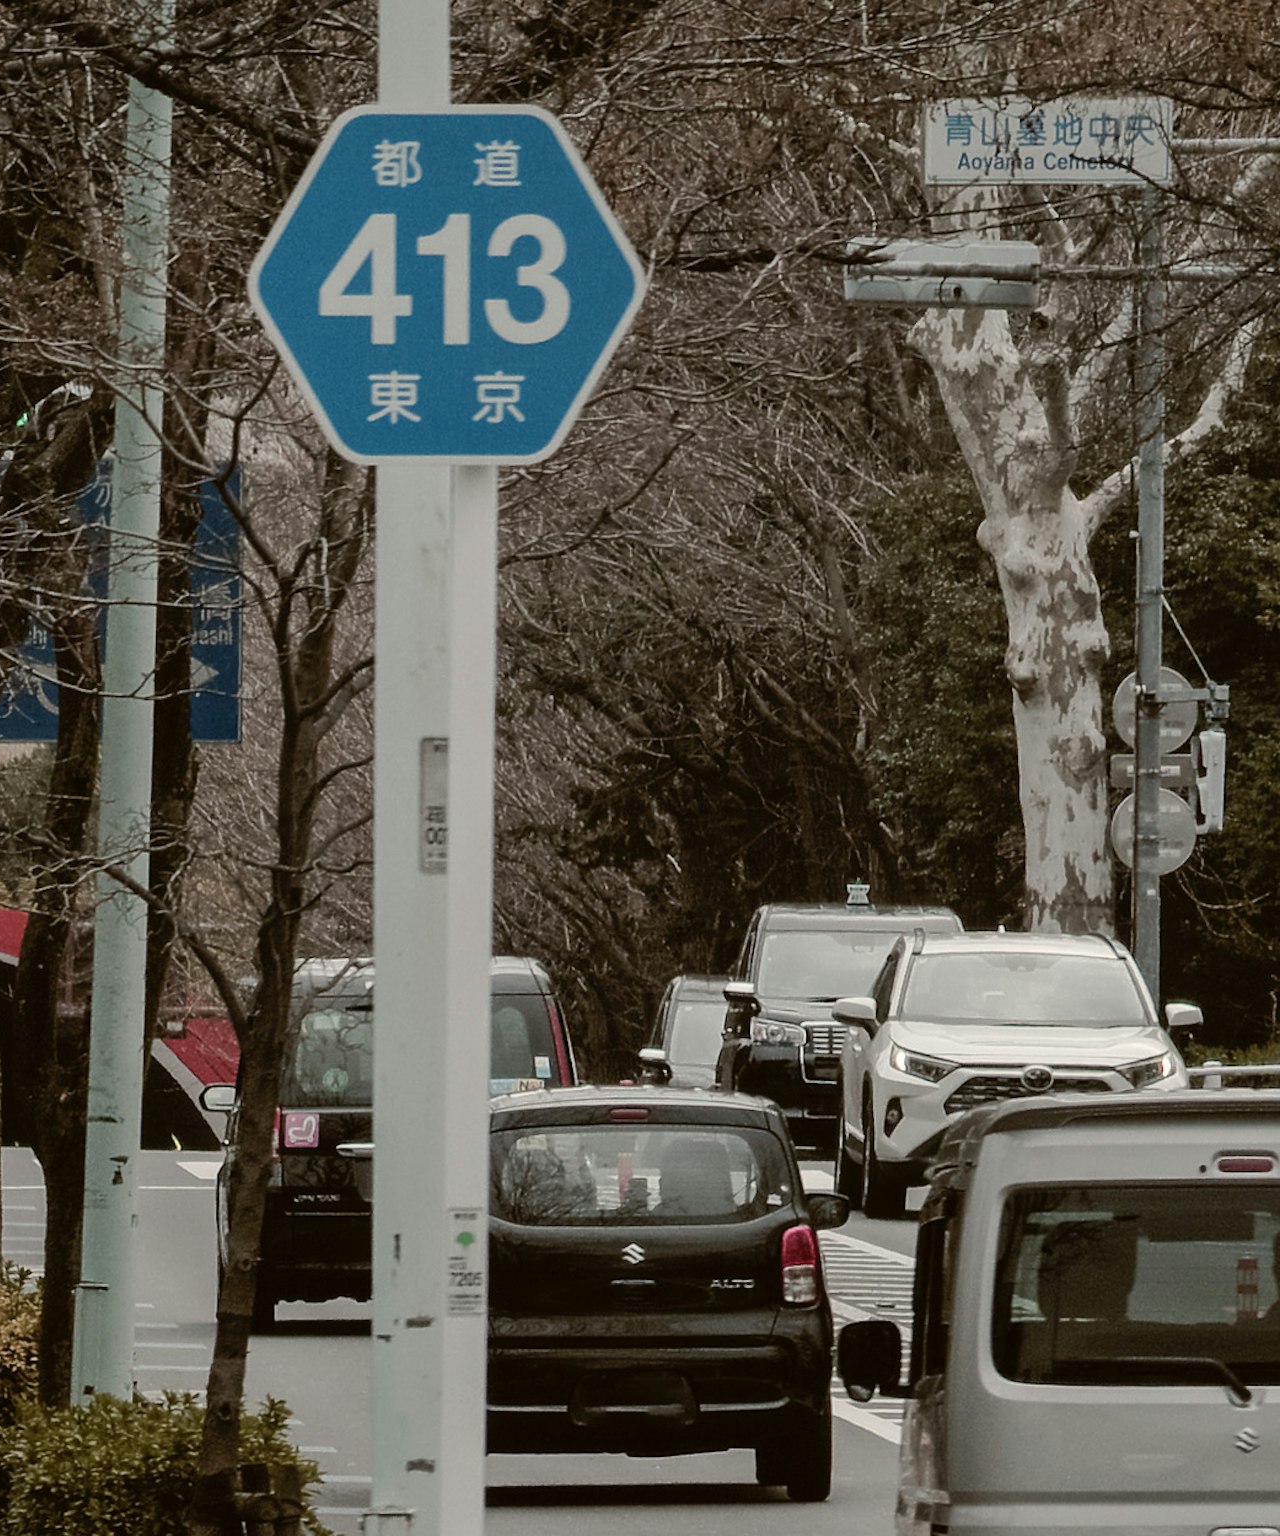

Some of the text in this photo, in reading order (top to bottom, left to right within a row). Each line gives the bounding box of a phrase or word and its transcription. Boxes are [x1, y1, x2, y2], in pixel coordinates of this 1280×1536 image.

[943, 111, 1156, 148] 青山墓地中央
[370, 139, 523, 189] 都道
[957, 152, 1135, 175] Aoyama Cemetery
[318, 212, 572, 346] 413
[366, 370, 526, 424] 東京
[709, 1278, 756, 1289] ALTO
